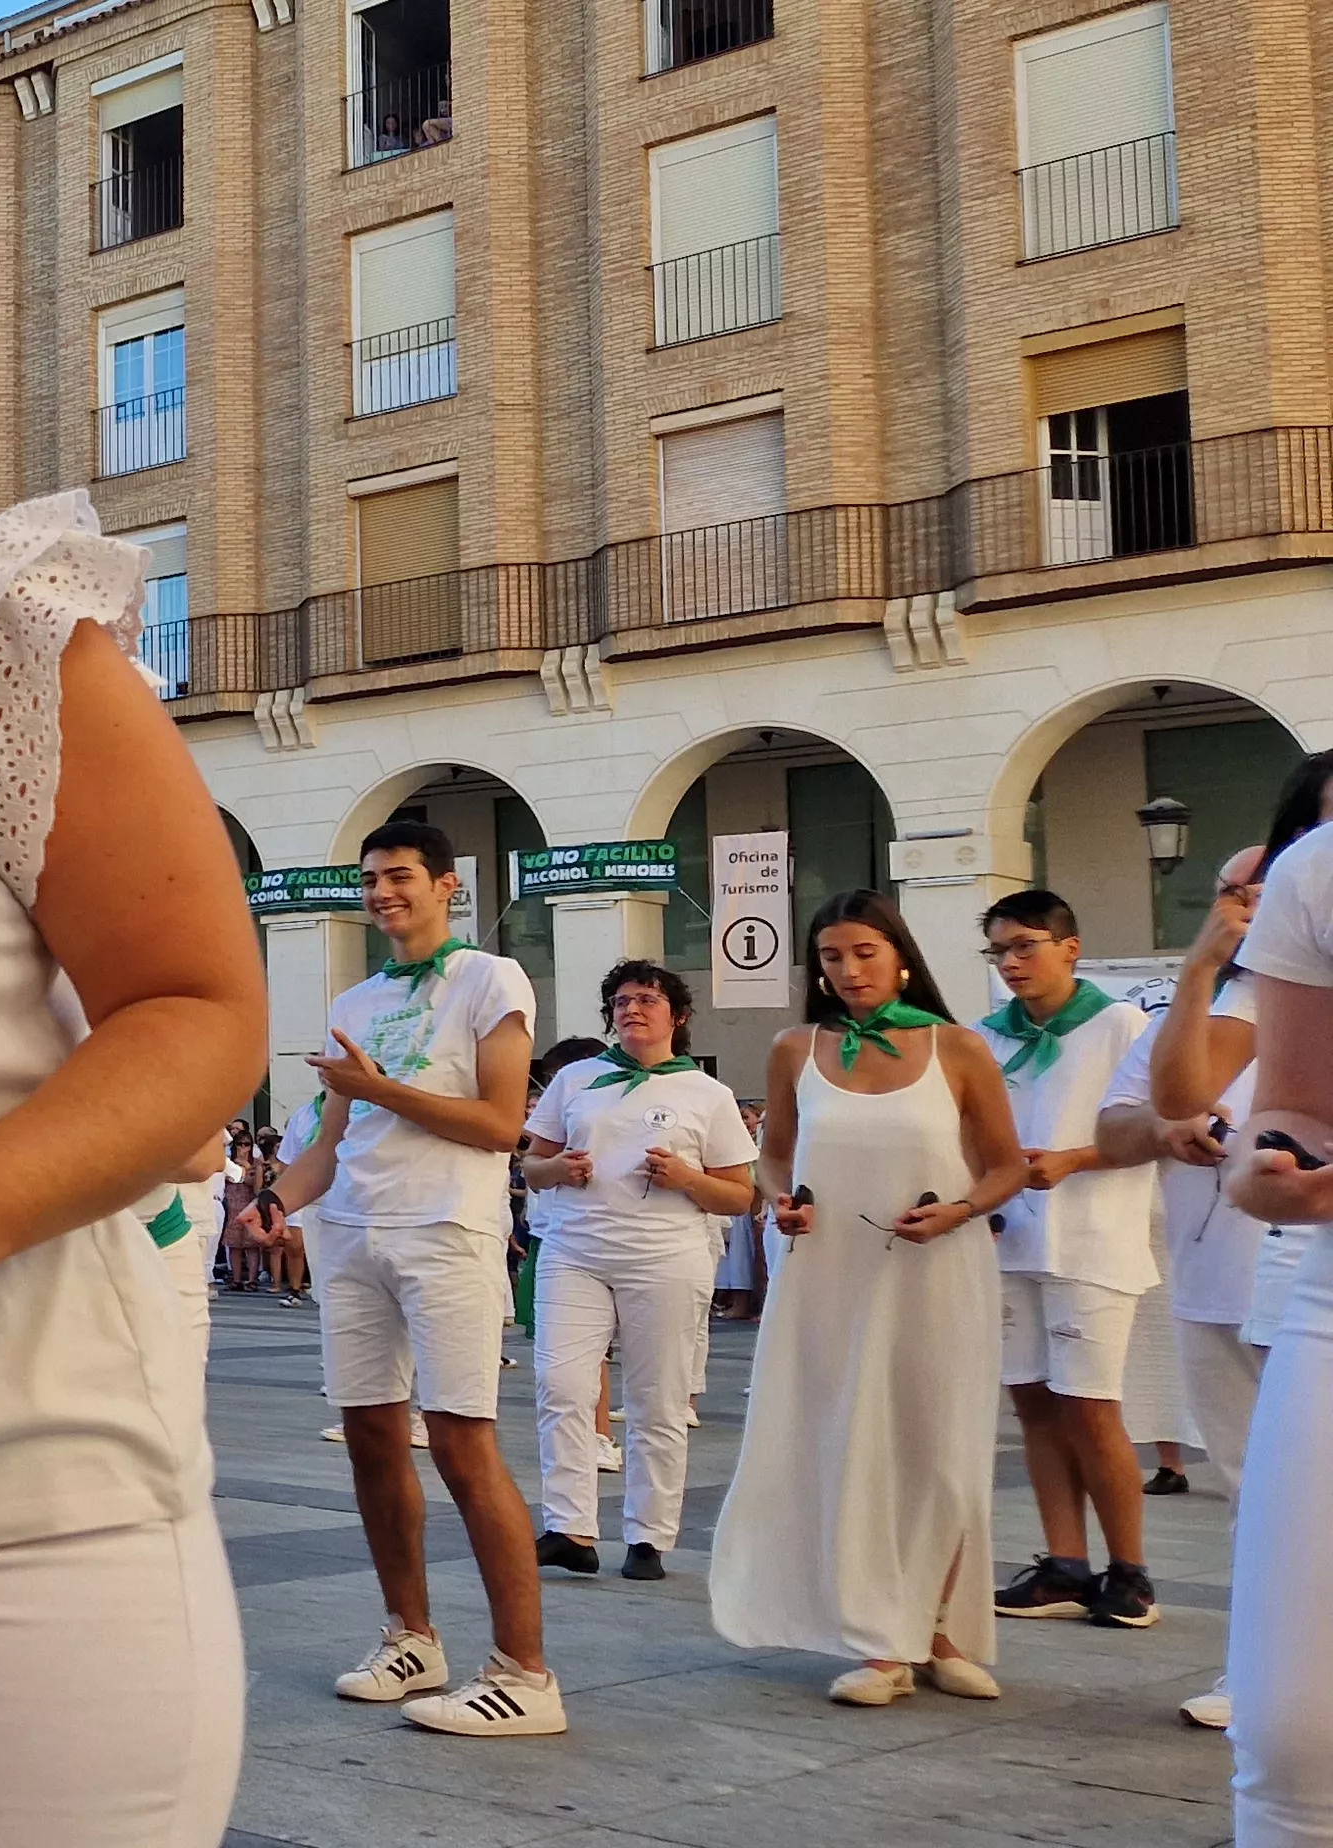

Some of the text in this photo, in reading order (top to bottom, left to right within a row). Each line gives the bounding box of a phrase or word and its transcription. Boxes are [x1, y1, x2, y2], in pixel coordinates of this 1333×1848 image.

[522, 844, 675, 868] YO NO FACILITO
[728, 851, 779, 864] Oficina
[261, 873, 283, 889] NO
[286, 868, 362, 885] FACILITO
[524, 864, 675, 885] ALCOHOL A MENORES
[760, 867, 779, 878] de
[303, 887, 363, 899] MENORES
[721, 883, 779, 895] Turismo
